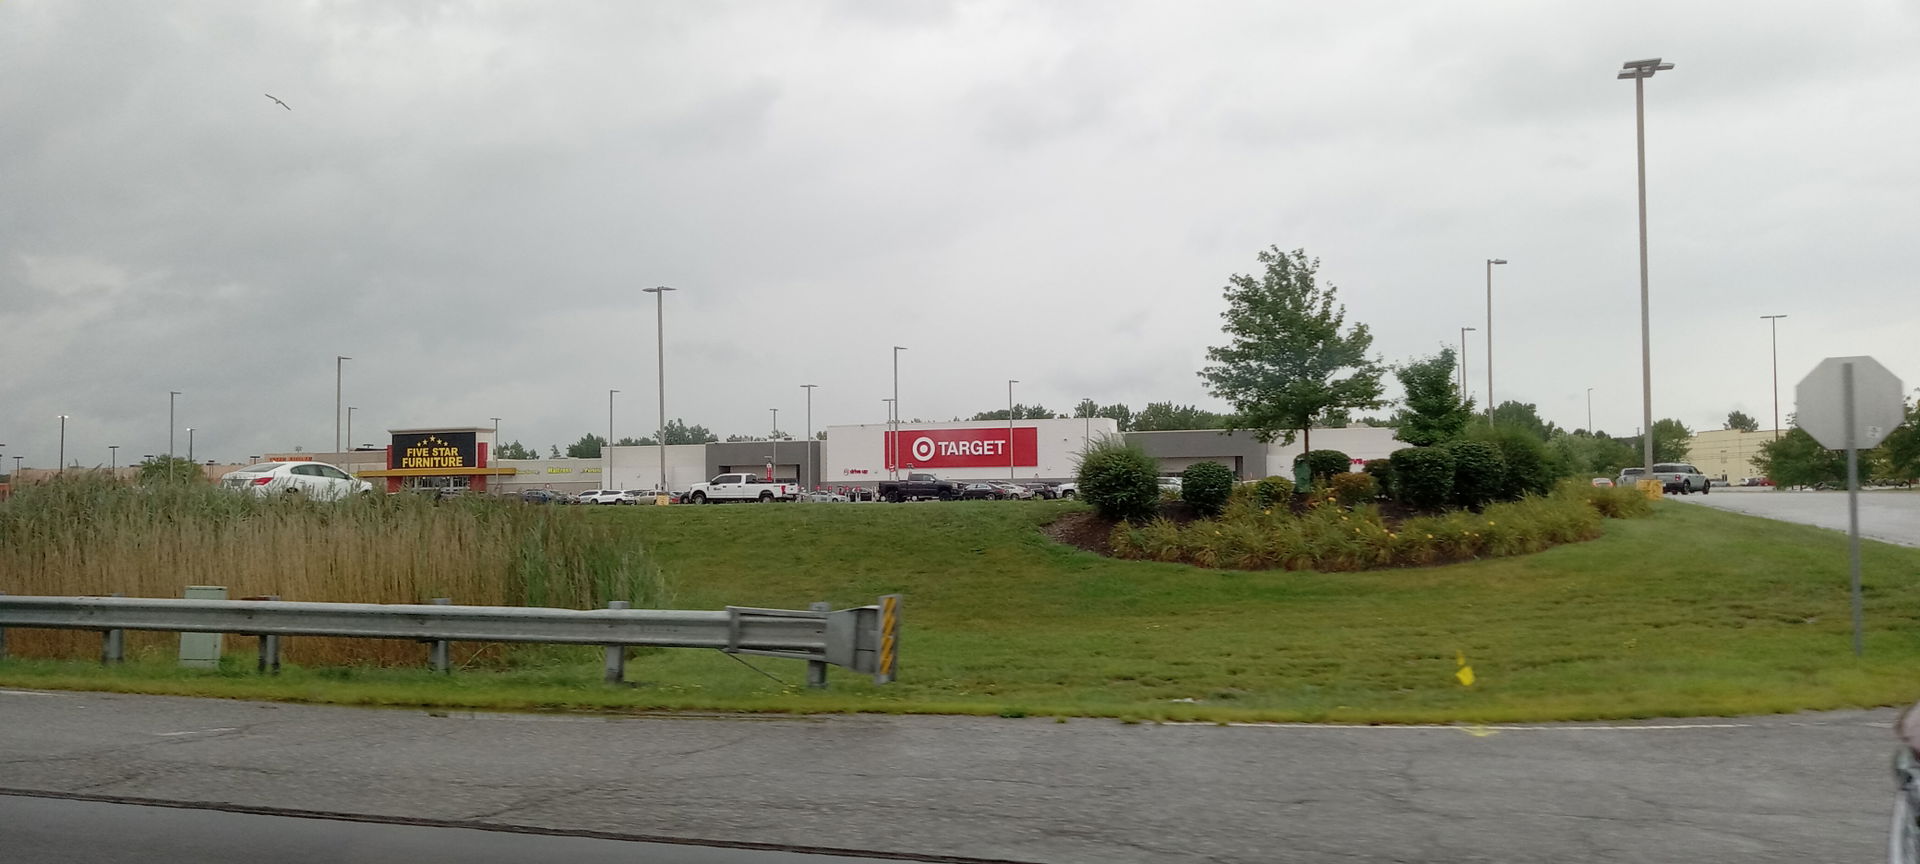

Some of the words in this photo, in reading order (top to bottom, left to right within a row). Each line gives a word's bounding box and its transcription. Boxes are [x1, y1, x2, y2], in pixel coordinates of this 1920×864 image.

[407, 448, 430, 457] FIVE
[432, 447, 458, 457] STAR
[938, 440, 1006, 456] TARGET
[402, 457, 463, 467] FURNITURE
